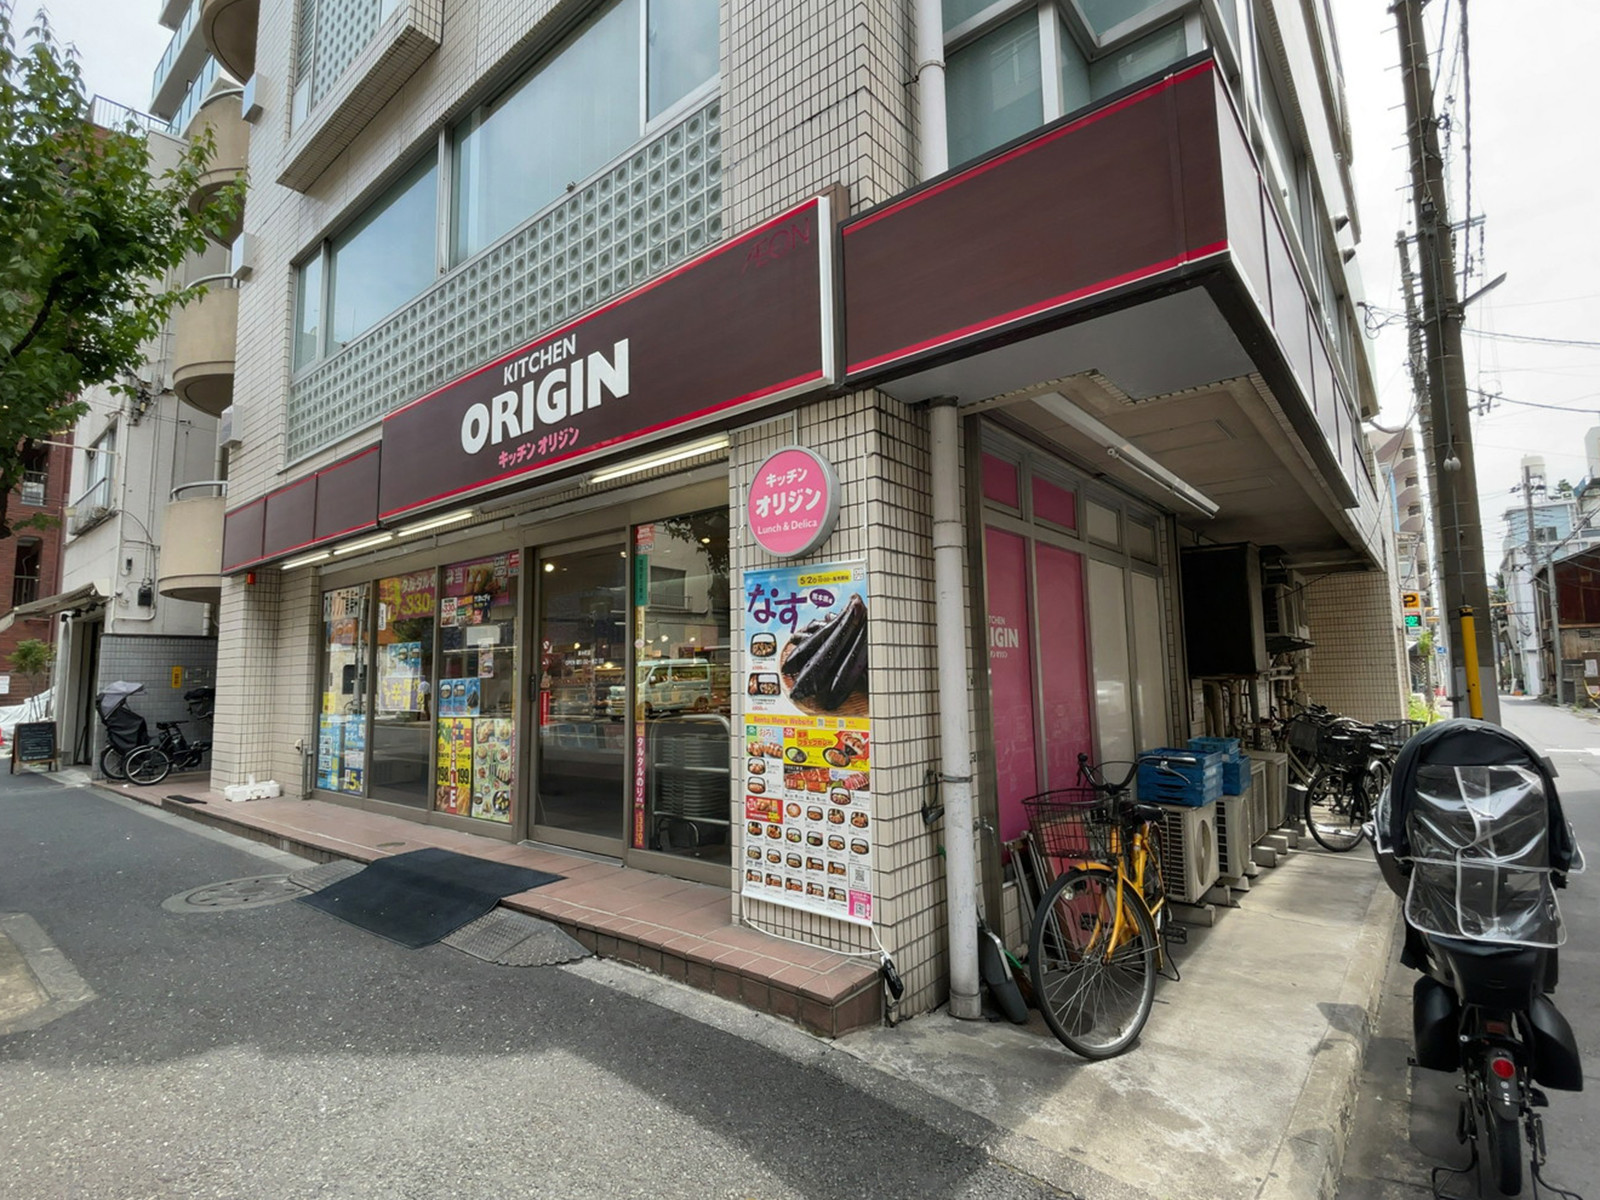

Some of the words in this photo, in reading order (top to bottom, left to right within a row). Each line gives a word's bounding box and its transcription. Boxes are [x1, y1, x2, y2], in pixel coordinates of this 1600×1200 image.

[503, 333, 577, 386] KITCHEN
[461, 338, 630, 455] ORIGIN
[765, 468, 808, 488] キッチン
[755, 488, 821, 518] オリジン
[757, 523, 782, 535] Lunch
[783, 522, 790, 531] &
[790, 518, 818, 530] Delica
[747, 583, 807, 633] なす
[989, 626, 1019, 648] IGIN
